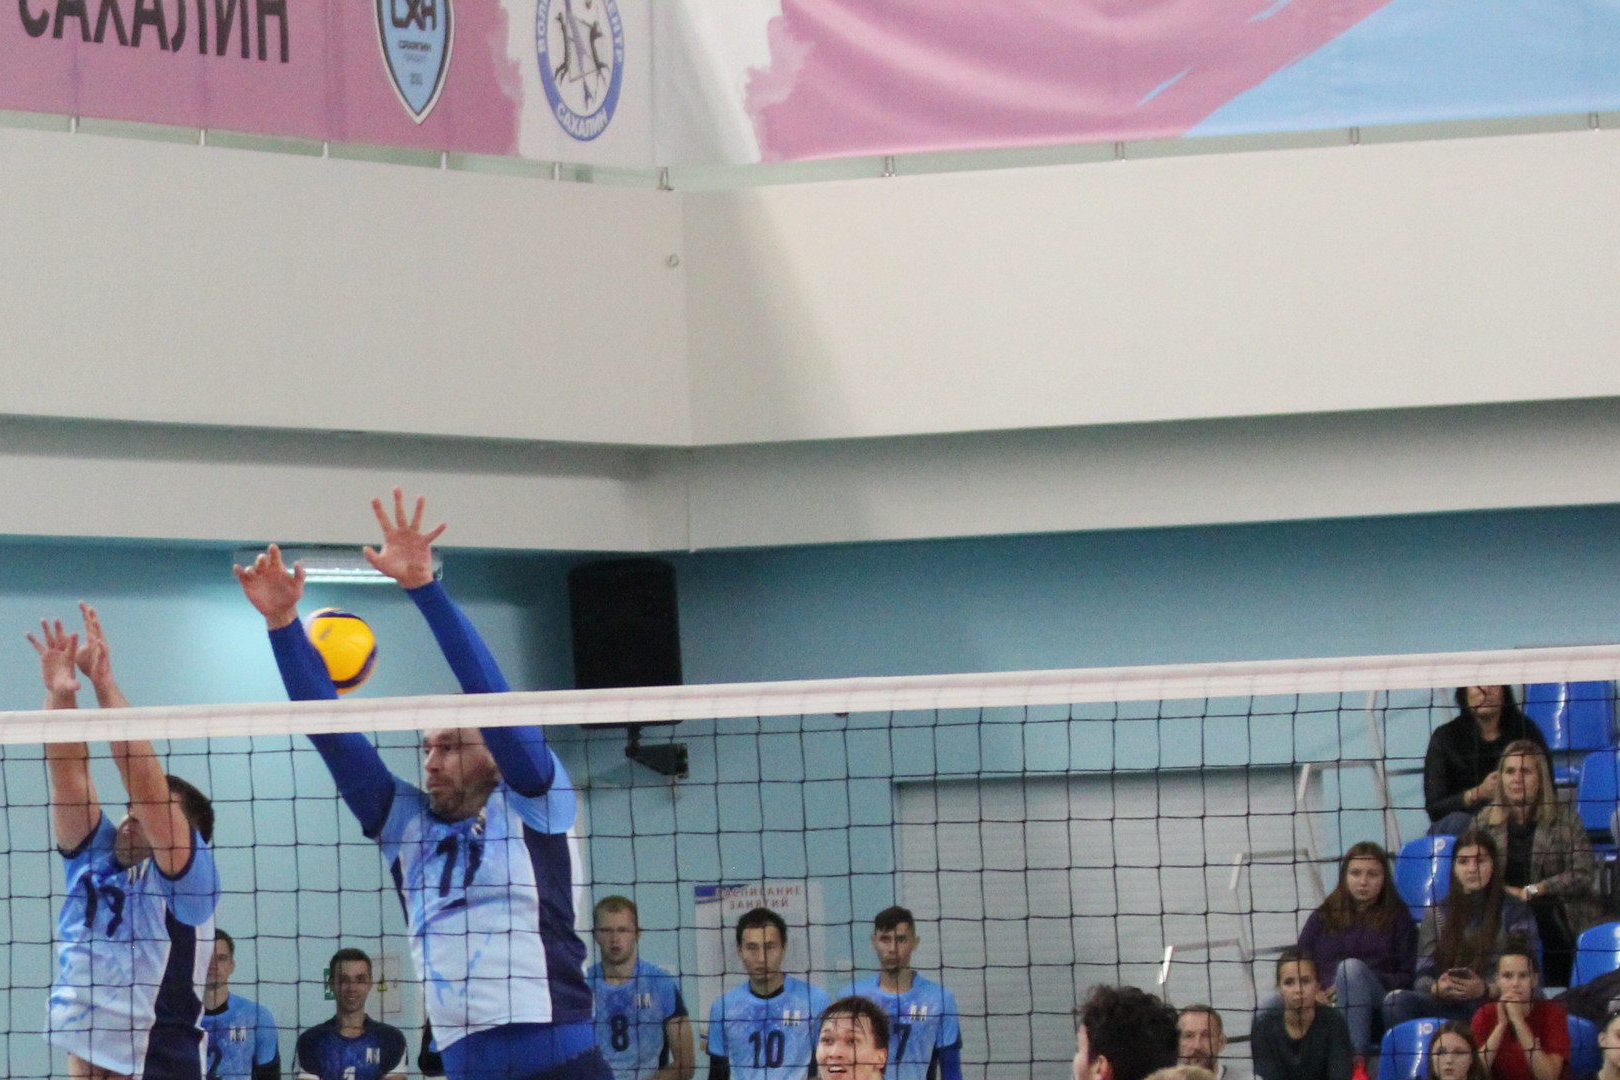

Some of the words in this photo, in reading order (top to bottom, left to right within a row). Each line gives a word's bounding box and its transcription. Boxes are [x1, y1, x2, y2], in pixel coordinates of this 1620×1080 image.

[557, 101, 608, 138] САХАЛИН
[610, 1013, 630, 1052] 8
[748, 1029, 785, 1069] 10
